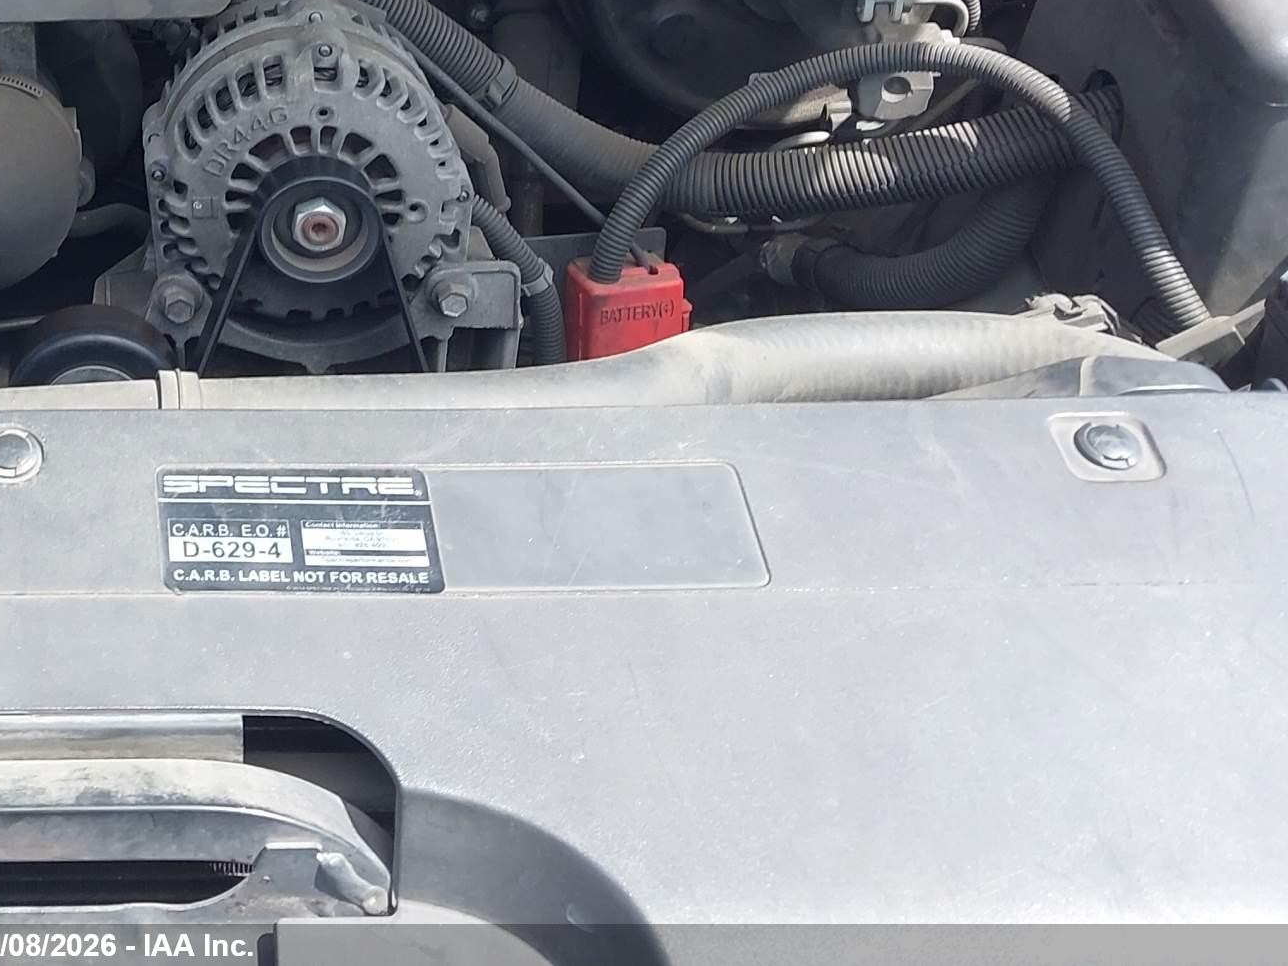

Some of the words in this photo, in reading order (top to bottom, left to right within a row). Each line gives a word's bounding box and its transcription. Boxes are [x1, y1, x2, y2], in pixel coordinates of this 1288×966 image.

[162, 475, 415, 495] SPECTRE
[172, 523, 233, 537] C.A.R.B.
[241, 524, 273, 537] E.O.
[276, 524, 287, 537] #
[183, 540, 281, 559] D-629-4
[173, 569, 236, 582] C.A.R.B.
[238, 570, 291, 583] LABEL
[293, 571, 326, 584] NOT
[329, 571, 364, 584] FOR
[365, 571, 430, 584] RESALE
